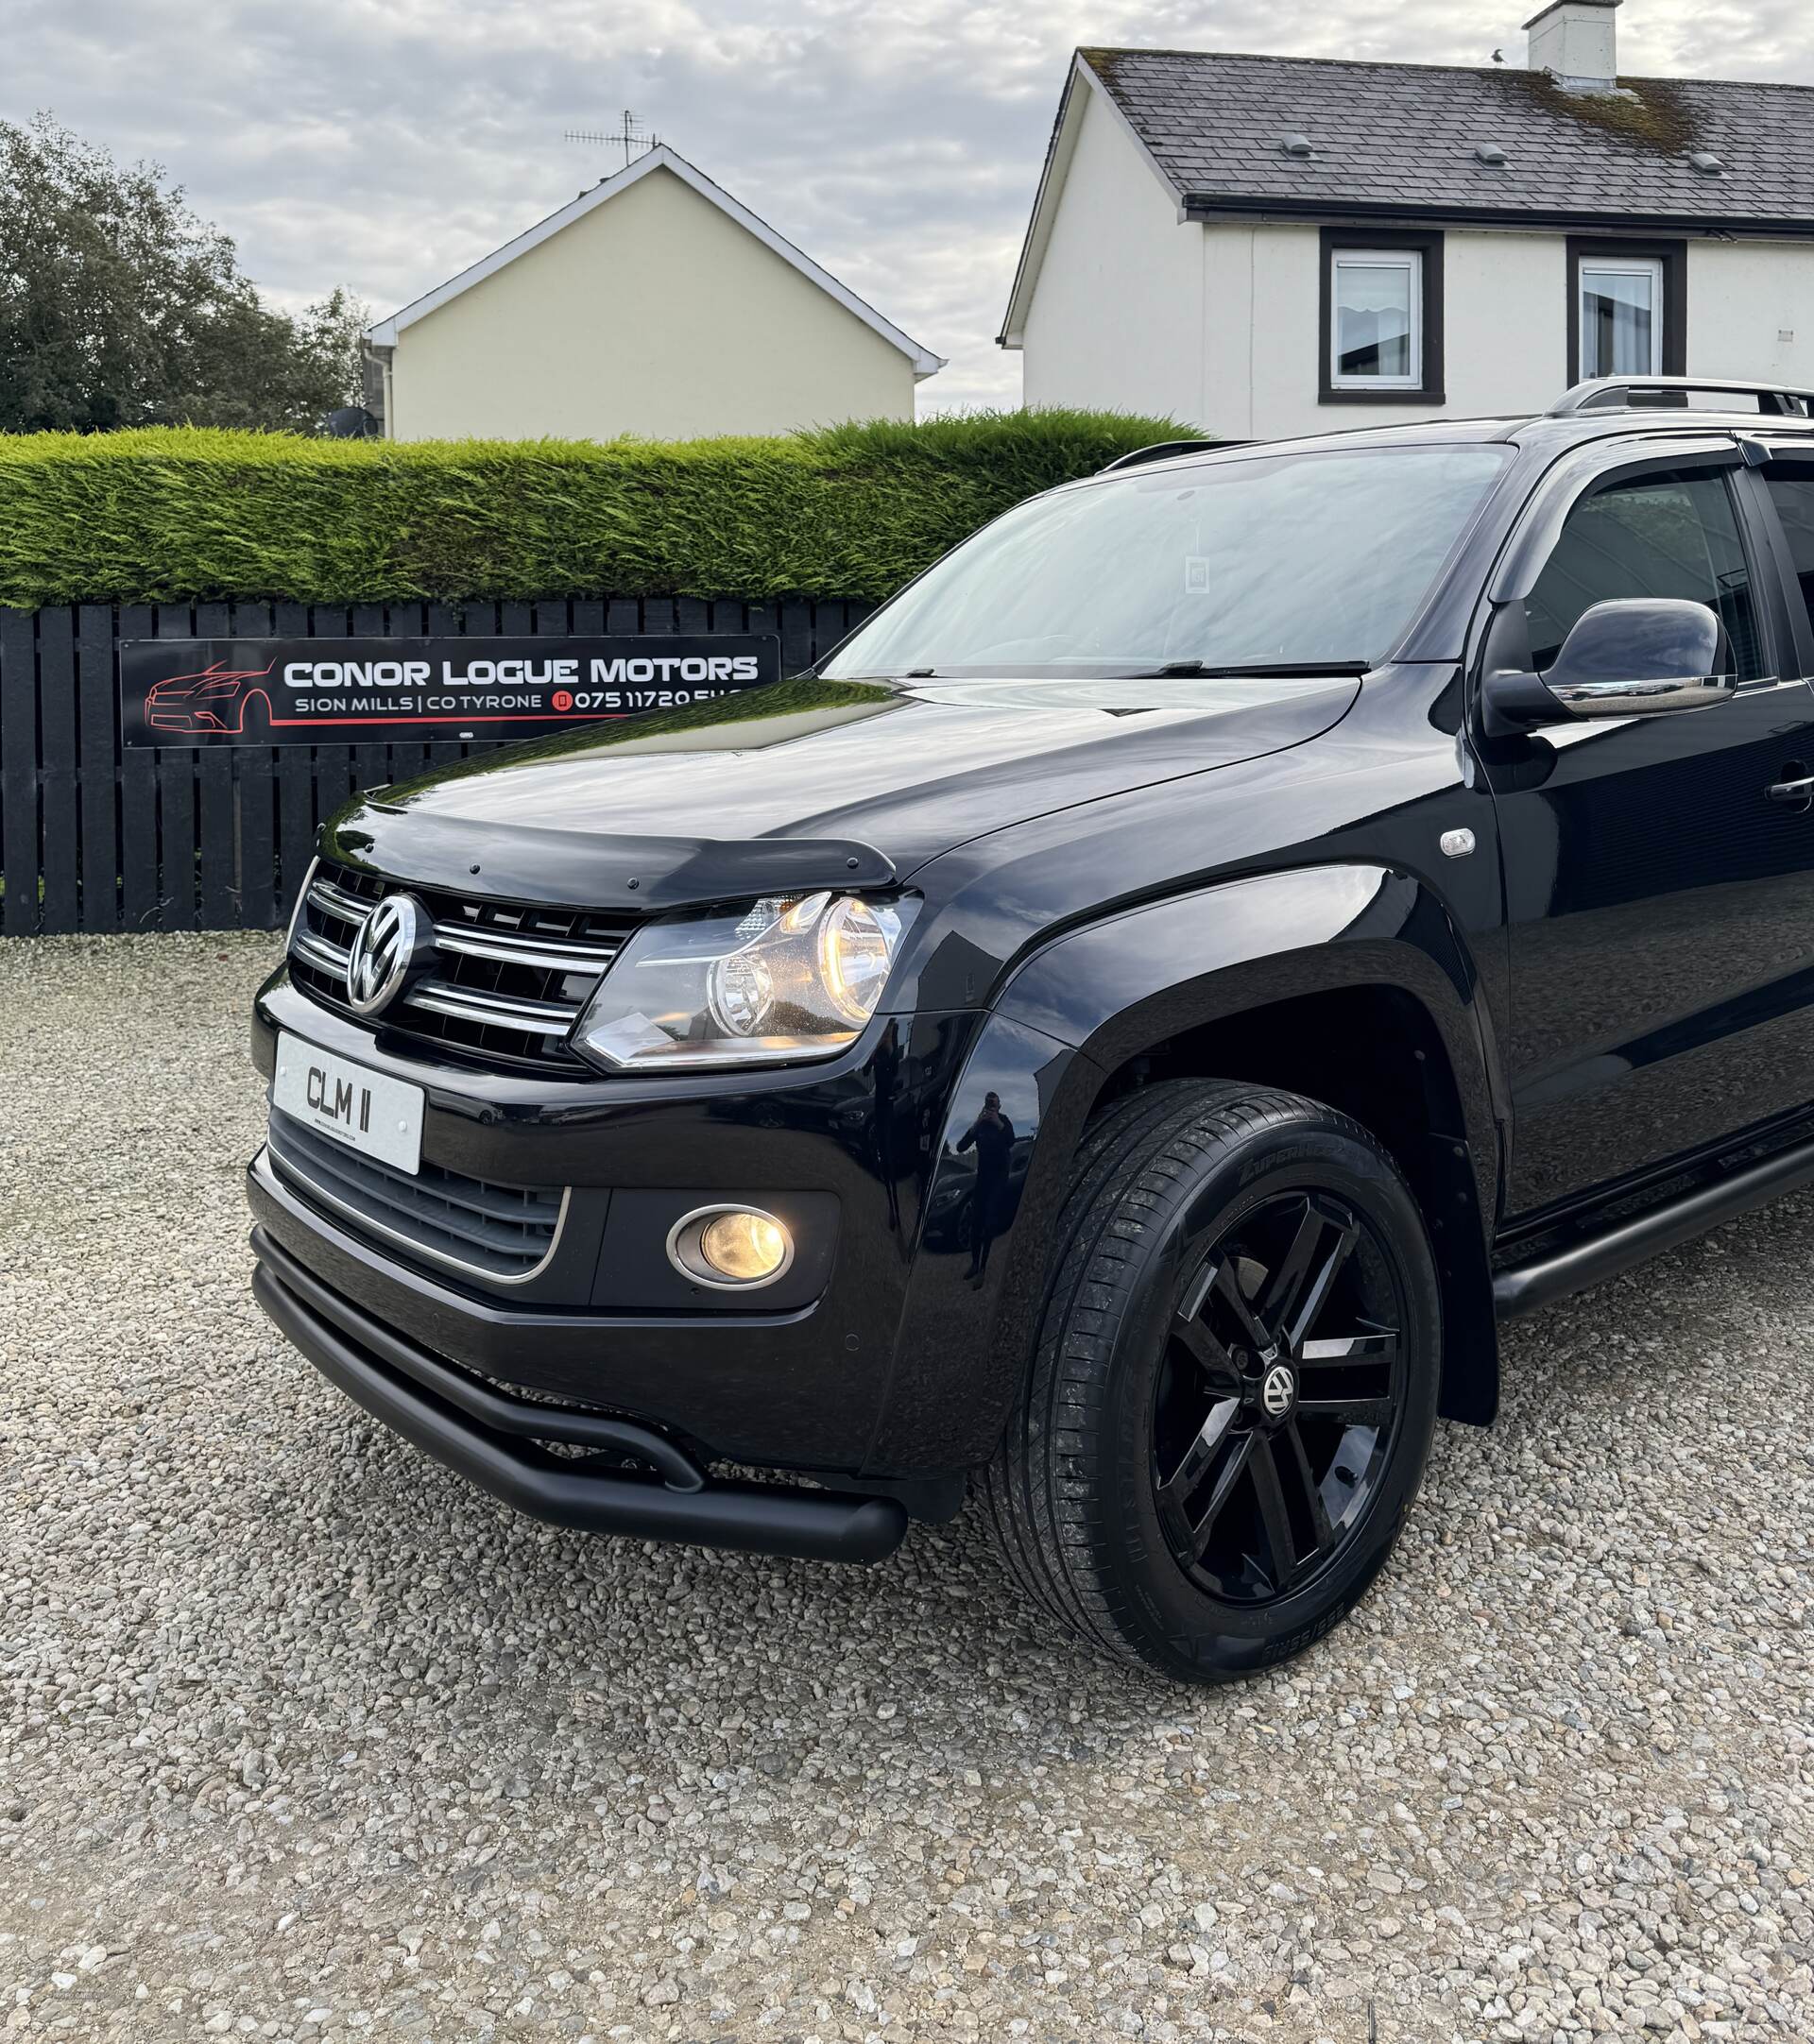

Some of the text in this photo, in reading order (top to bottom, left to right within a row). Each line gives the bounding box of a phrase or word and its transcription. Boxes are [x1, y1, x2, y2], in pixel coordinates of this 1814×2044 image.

[284, 656, 759, 688] CONOR LOGUE MOTORS
[295, 694, 542, 712] SION MILLS CO TYRONE
[574, 691, 622, 708] 075
[306, 1065, 353, 1126] CLM
